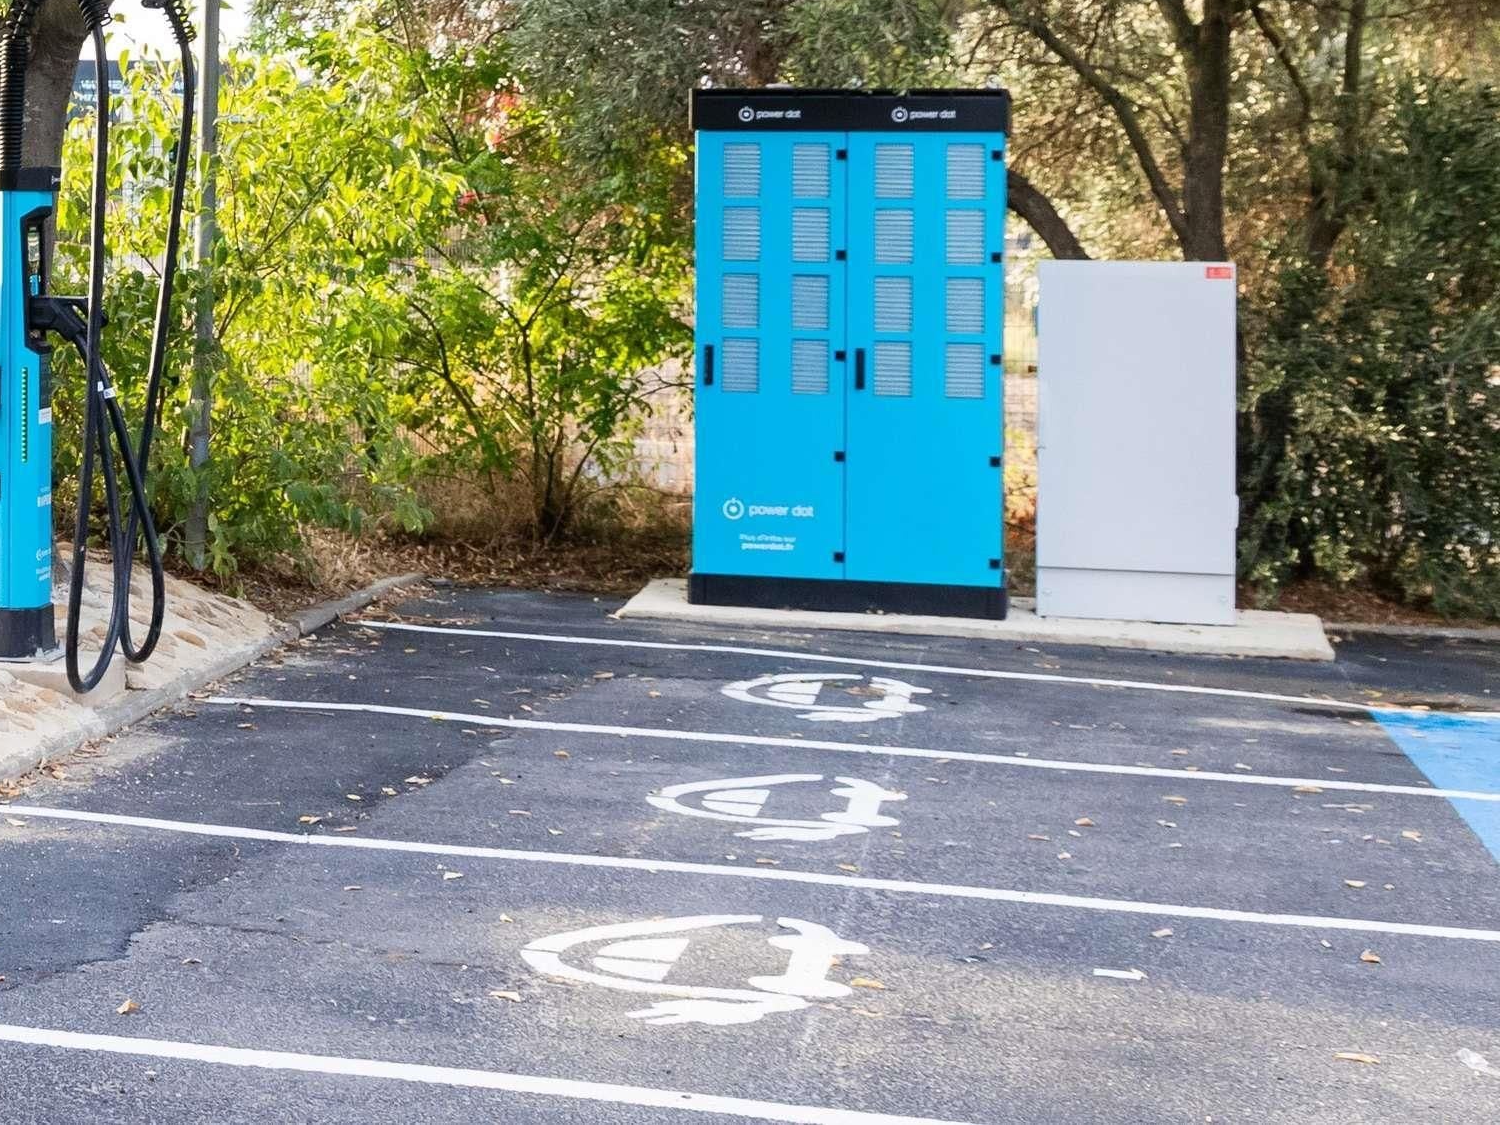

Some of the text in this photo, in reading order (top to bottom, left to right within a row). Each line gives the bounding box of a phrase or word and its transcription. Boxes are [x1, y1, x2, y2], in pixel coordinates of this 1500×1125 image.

[755, 109, 802, 120] power dot
[909, 109, 957, 121] power dot
[748, 504, 814, 518] power dot
